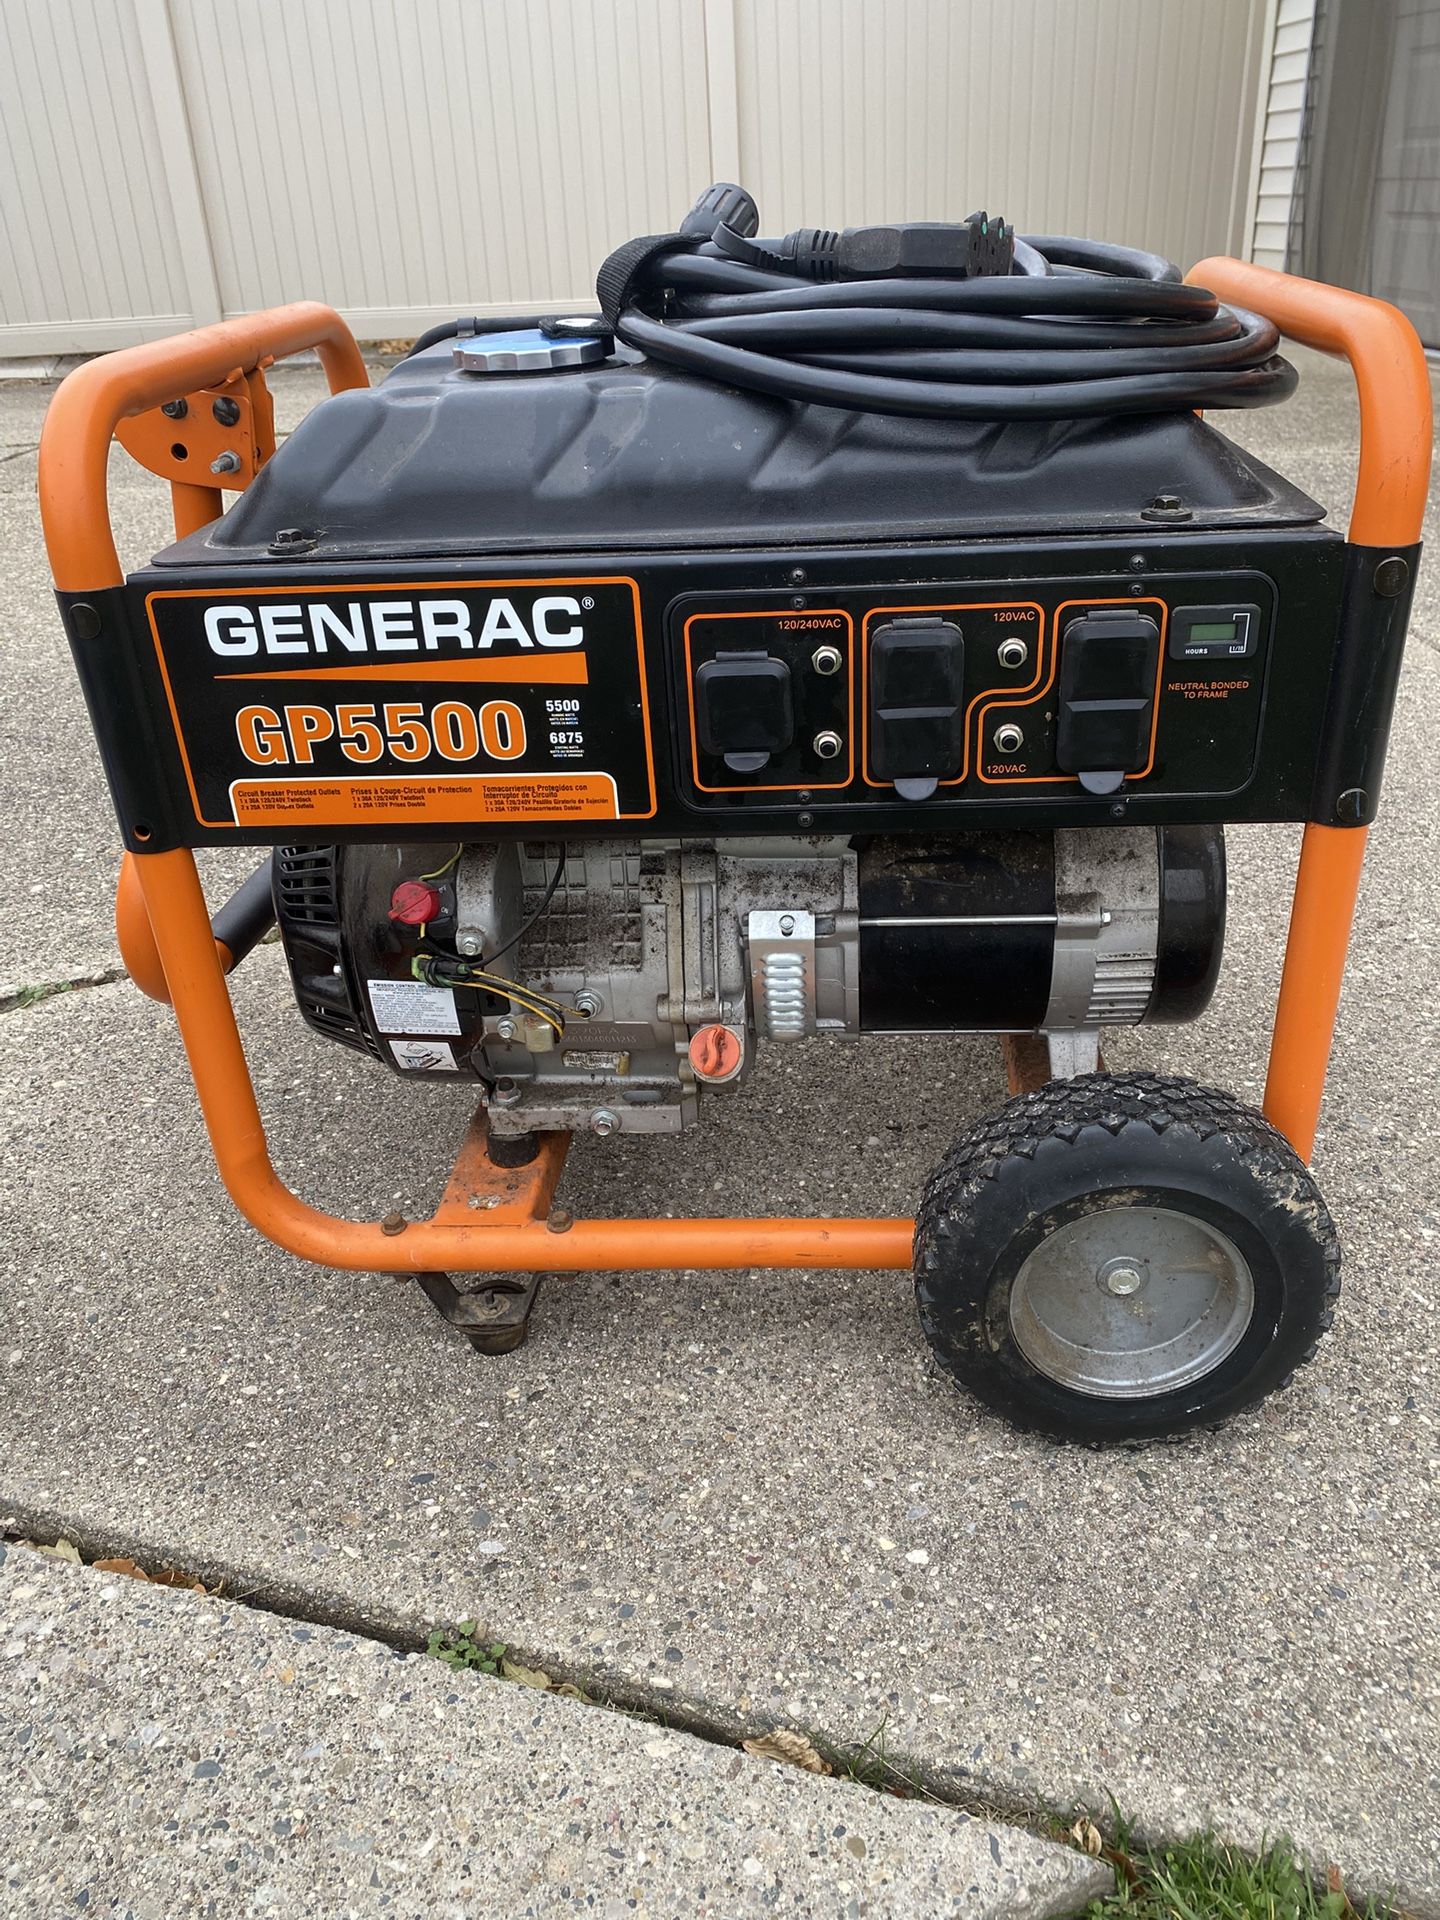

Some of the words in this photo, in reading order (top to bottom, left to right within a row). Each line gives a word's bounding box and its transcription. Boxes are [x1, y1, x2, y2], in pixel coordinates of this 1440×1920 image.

[993, 611, 1035, 622] 120VAC
[778, 619, 841, 630] 120/240VAC
[1168, 682, 1209, 690] NEUTRAL
[1211, 681, 1249, 689] BONDED
[1184, 691, 1195, 699] TO
[1198, 690, 1228, 698] FRAME
[546, 700, 580, 712] 5500
[236, 700, 526, 765] GP5500
[550, 732, 583, 744] 6875
[987, 764, 1027, 774] 120VAC
[380, 786, 425, 795] Coupe-Circuit
[428, 786, 436, 794] de
